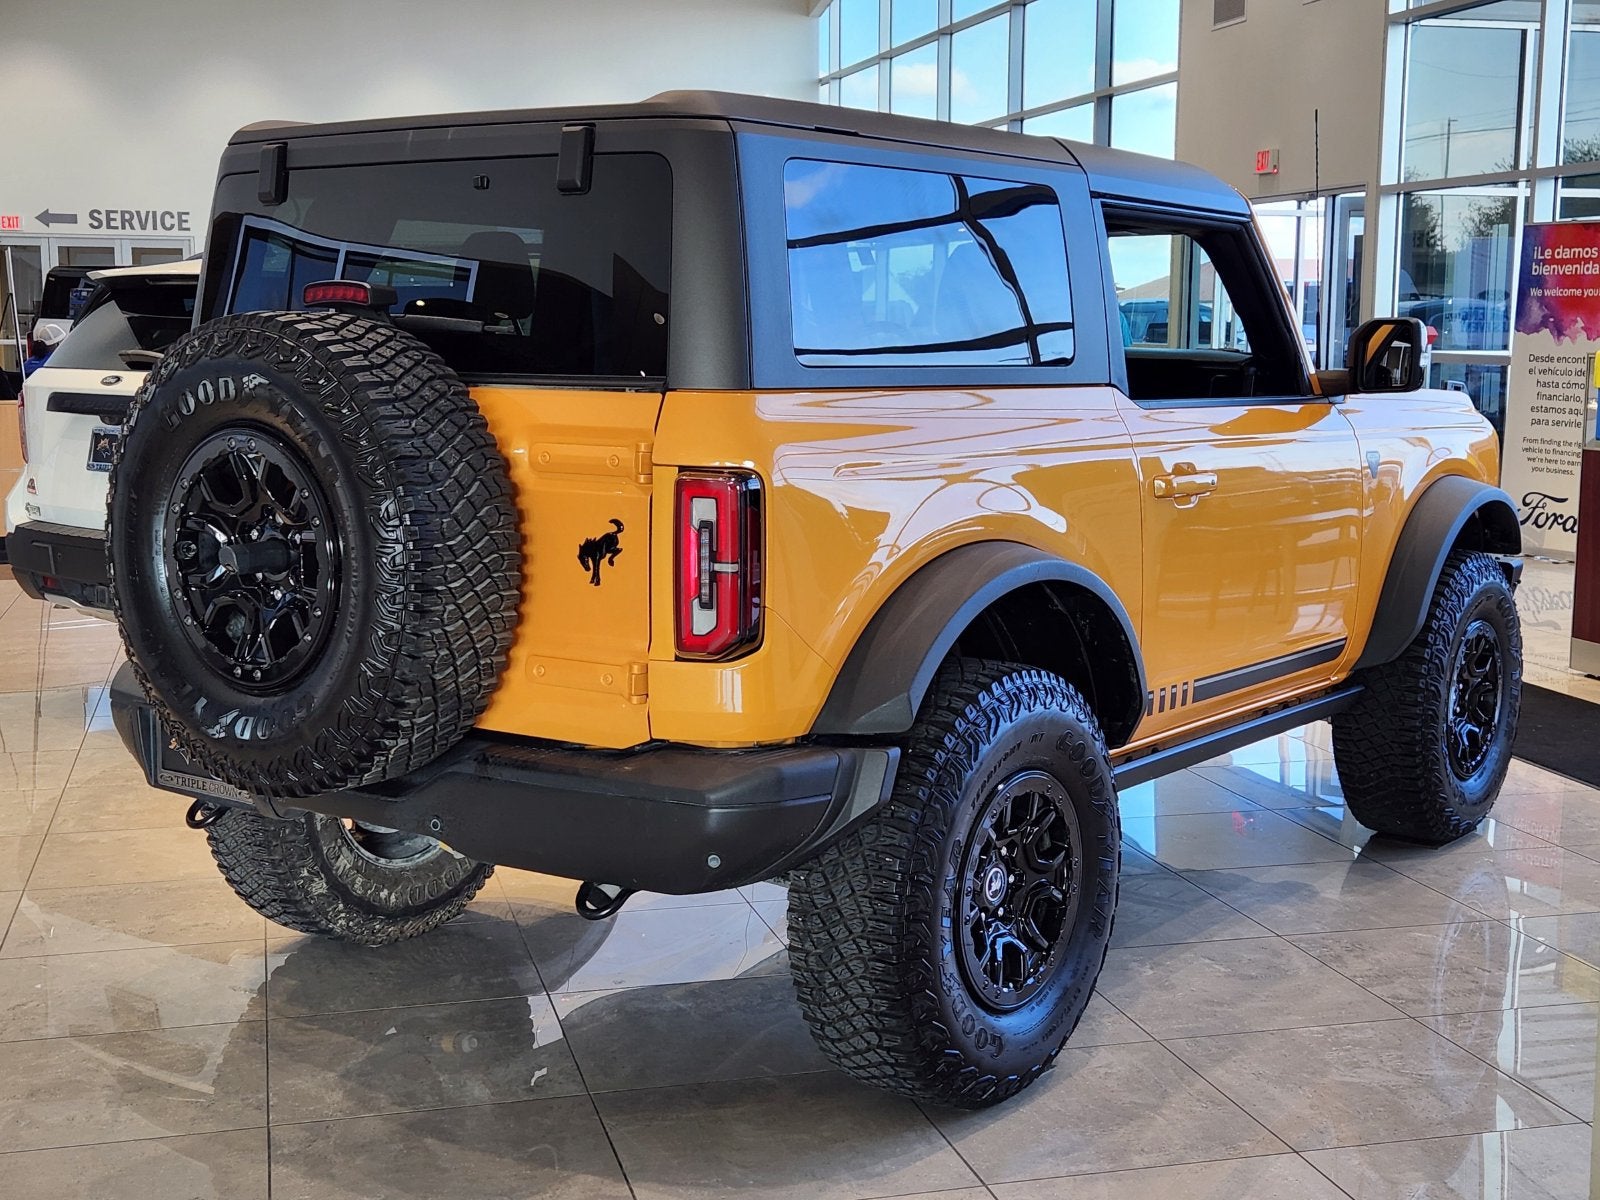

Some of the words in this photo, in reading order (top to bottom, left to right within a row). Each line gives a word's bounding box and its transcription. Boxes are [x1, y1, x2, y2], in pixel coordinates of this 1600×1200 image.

[2, 216, 19, 228] EXIT
[88, 209, 191, 231] SERVICE
[1554, 245, 1598, 259] damos
[1531, 261, 1600, 276] bienvenida
[1530, 287, 1543, 297] We
[1544, 287, 1582, 297] welcome
[1528, 353, 1555, 363] Desde
[1528, 366, 1537, 375] el
[1538, 367, 1573, 377] vehículo
[1536, 379, 1560, 389] hasta
[1561, 380, 1586, 390] cómo
[1536, 391, 1583, 404] financiarlo,
[1530, 405, 1567, 415] estamos
[1530, 418, 1550, 427] para
[1551, 419, 1582, 429] servirle
[1540, 438, 1562, 447] finding
[1521, 446, 1543, 454] vehicle
[1526, 456, 1544, 464] we're
[1544, 457, 1559, 465] here
[1545, 466, 1575, 476] business.
[174, 775, 207, 791] TRIPLE
[208, 782, 238, 798] CROWN
